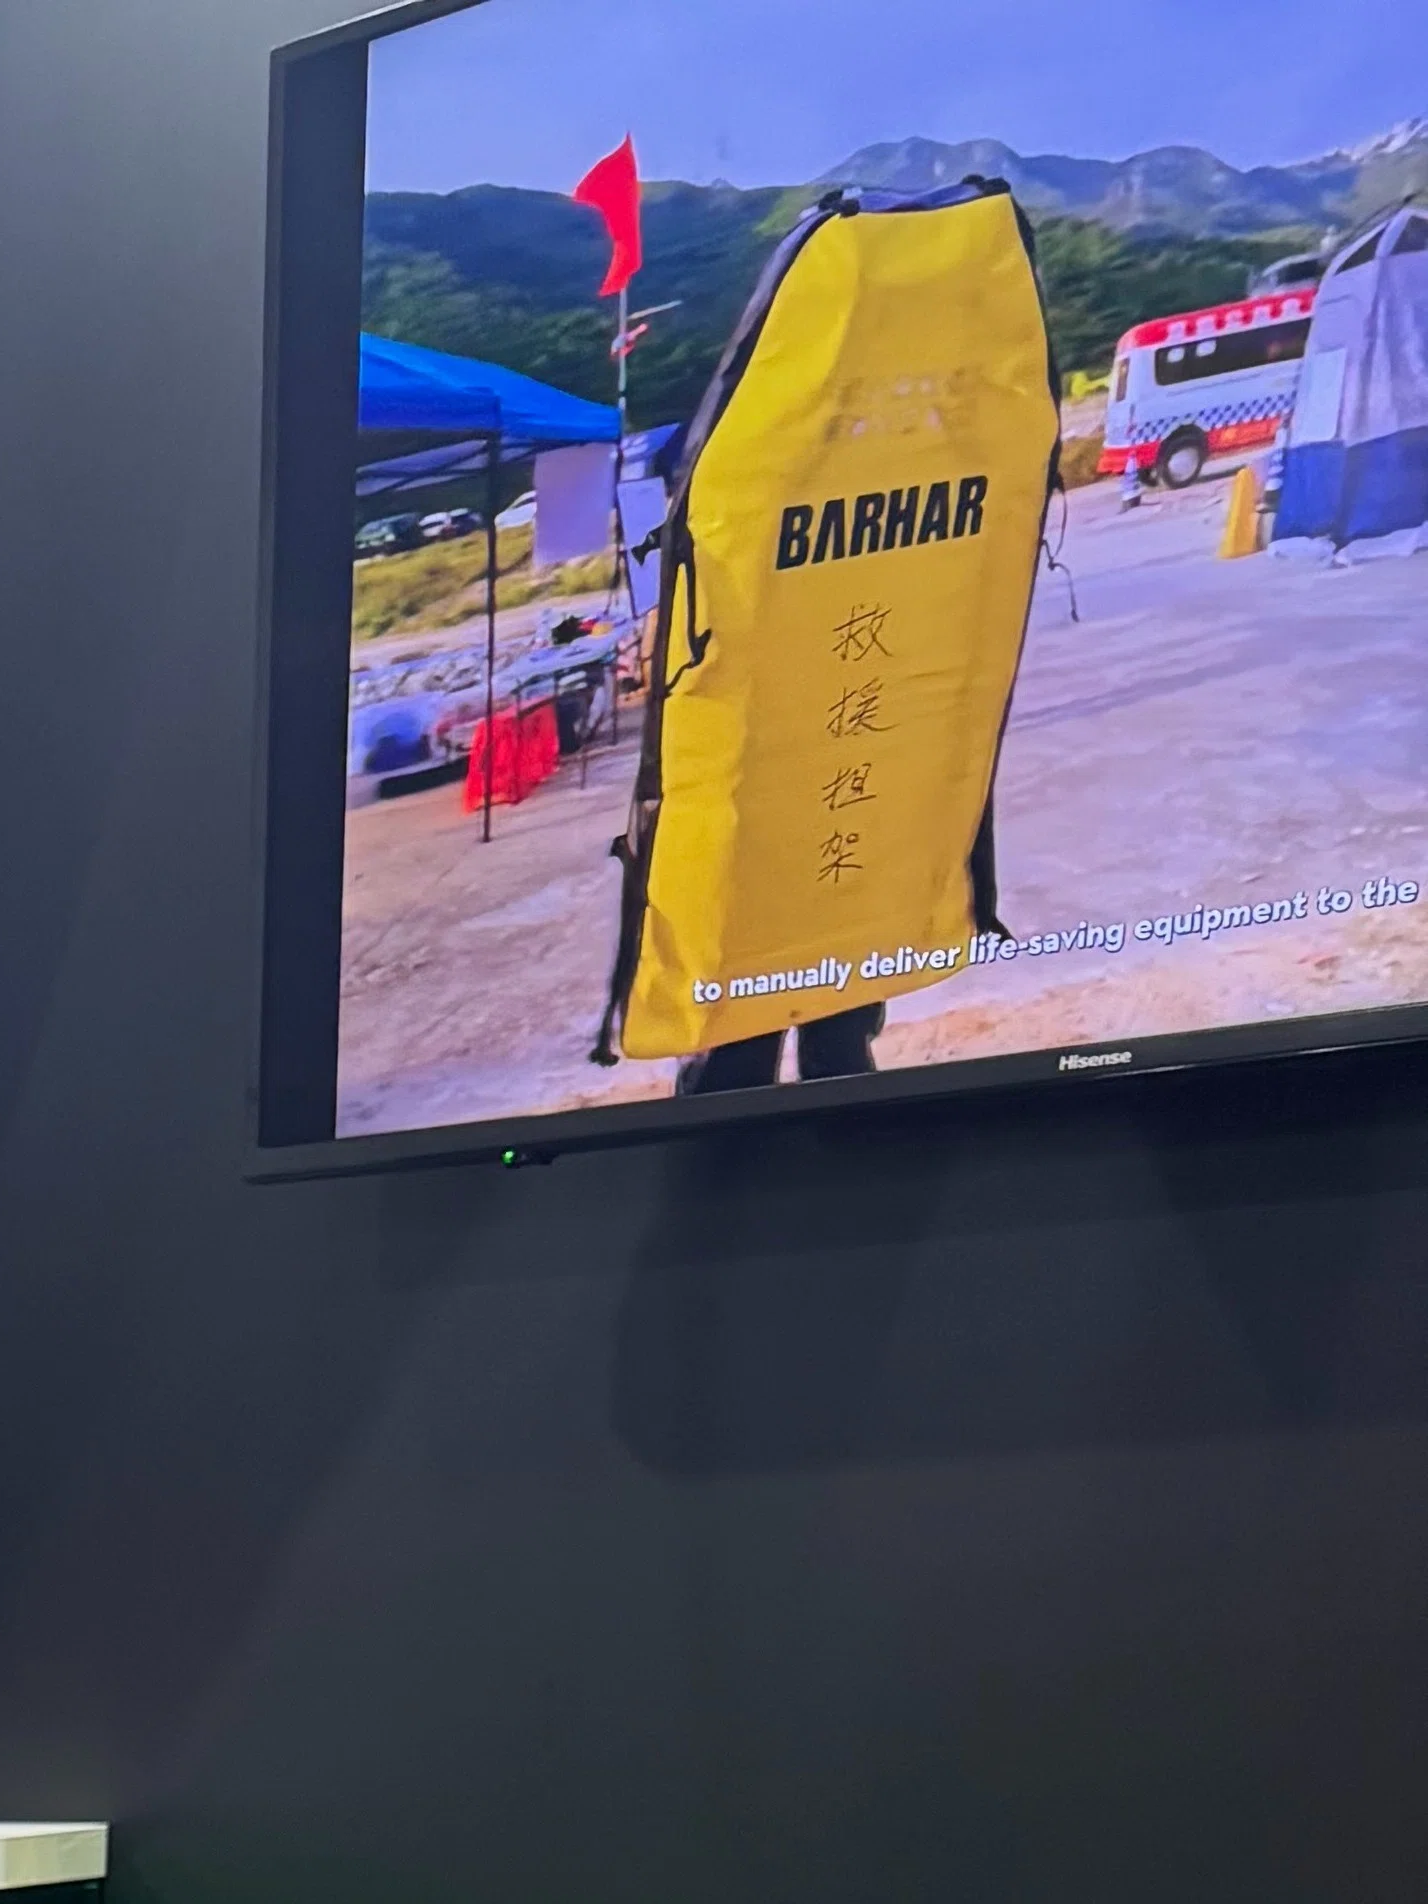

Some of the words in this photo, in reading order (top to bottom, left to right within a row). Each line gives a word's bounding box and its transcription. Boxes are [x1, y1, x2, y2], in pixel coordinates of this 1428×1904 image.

[776, 475, 988, 570] BARHAR
[694, 979, 722, 1003] to
[729, 957, 852, 998] manually
[859, 946, 962, 980] deliver
[968, 919, 1126, 965] life-saving
[1134, 891, 1310, 946] equipment
[1317, 886, 1353, 915] to
[1361, 876, 1419, 909] the
[1058, 1050, 1133, 1072] Hisense
